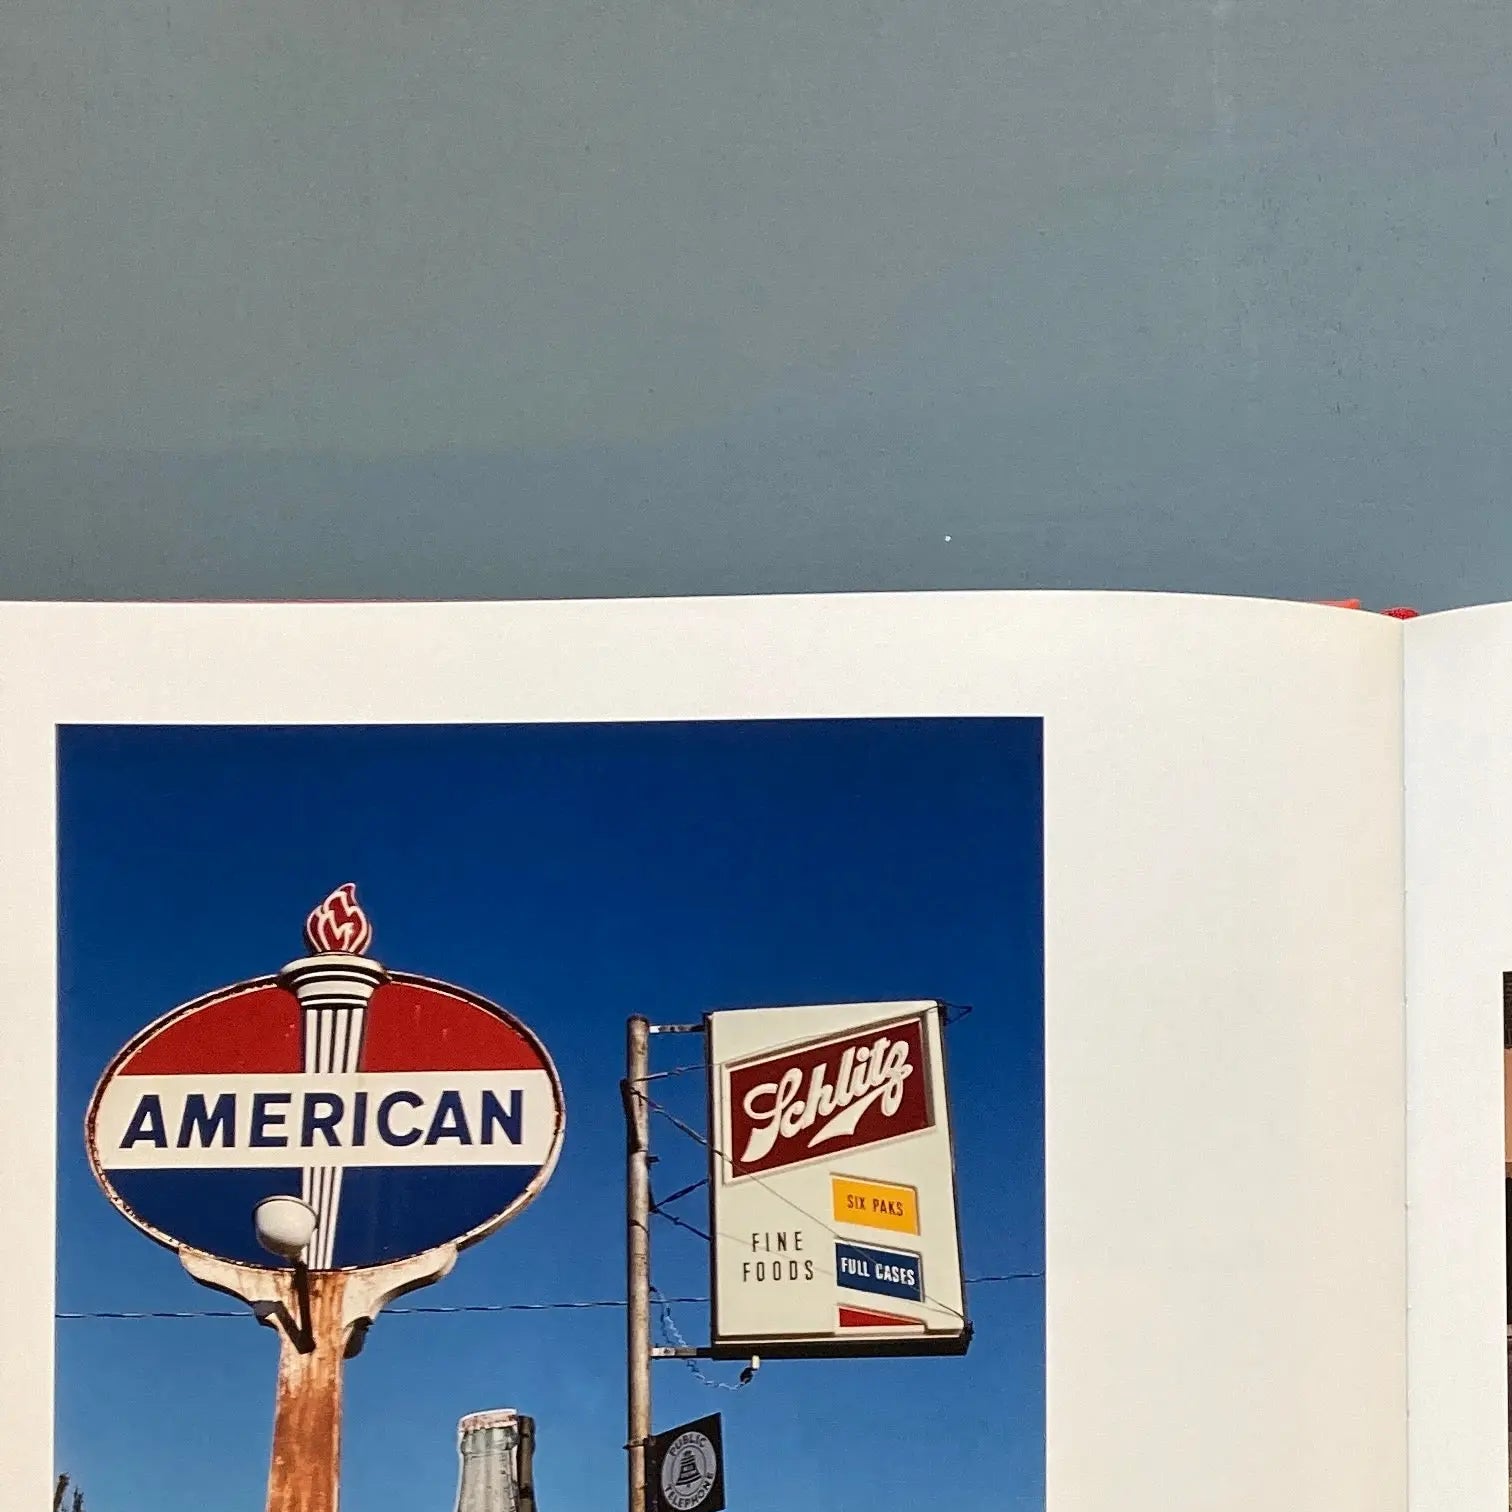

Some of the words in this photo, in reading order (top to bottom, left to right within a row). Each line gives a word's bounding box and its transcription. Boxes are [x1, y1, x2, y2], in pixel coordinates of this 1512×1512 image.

[740, 1036, 914, 1164] Schlitz
[118, 1088, 525, 1150] AMERICAN
[846, 1194, 867, 1211] SIX
[872, 1198, 905, 1217] PAKS
[752, 1230, 805, 1253] FINE
[743, 1259, 815, 1283] FOODS
[840, 1256, 870, 1278] FULL
[874, 1262, 916, 1287] CASES
[669, 1433, 708, 1457] PUBLIC
[663, 1471, 715, 1509] TELEPHONE
